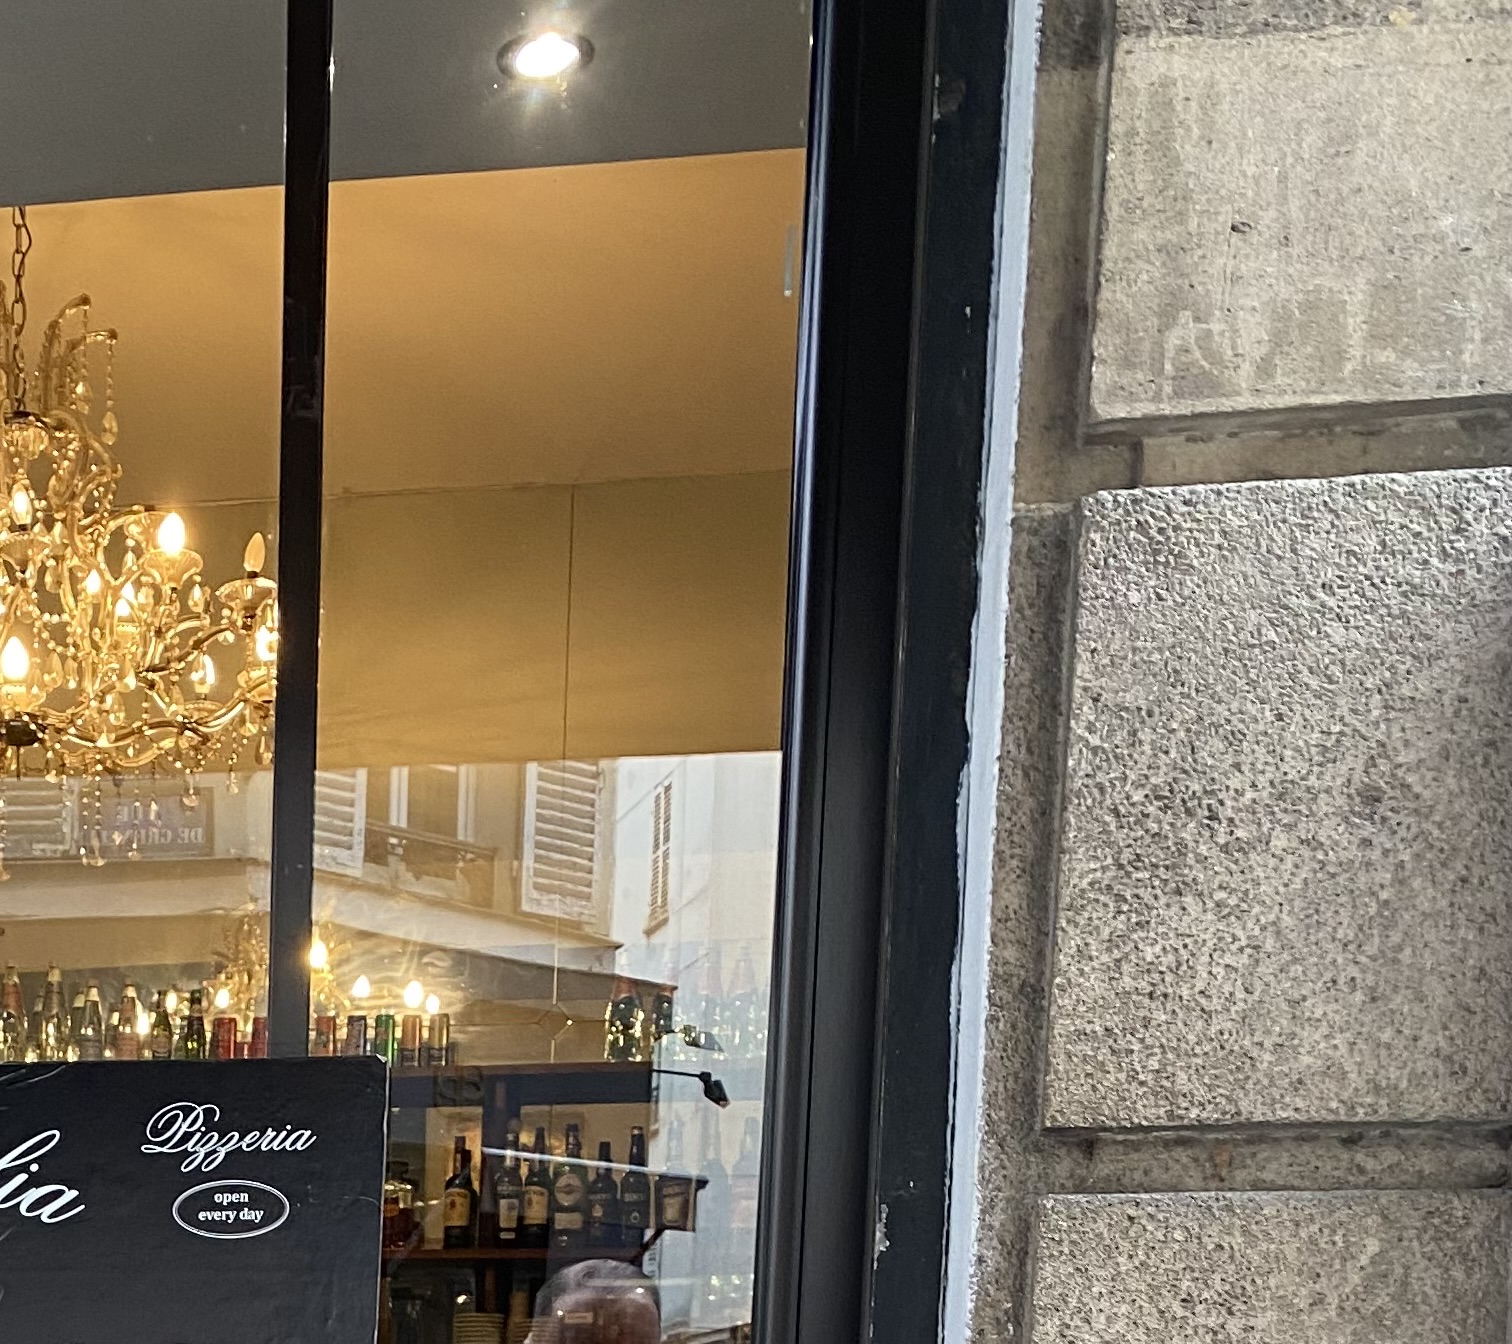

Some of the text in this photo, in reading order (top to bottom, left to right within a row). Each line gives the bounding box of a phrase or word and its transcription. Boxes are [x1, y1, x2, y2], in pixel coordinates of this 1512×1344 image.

[140, 1102, 317, 1173] Pizzeria
[214, 1192, 249, 1205] open
[198, 1208, 264, 1223] every day
